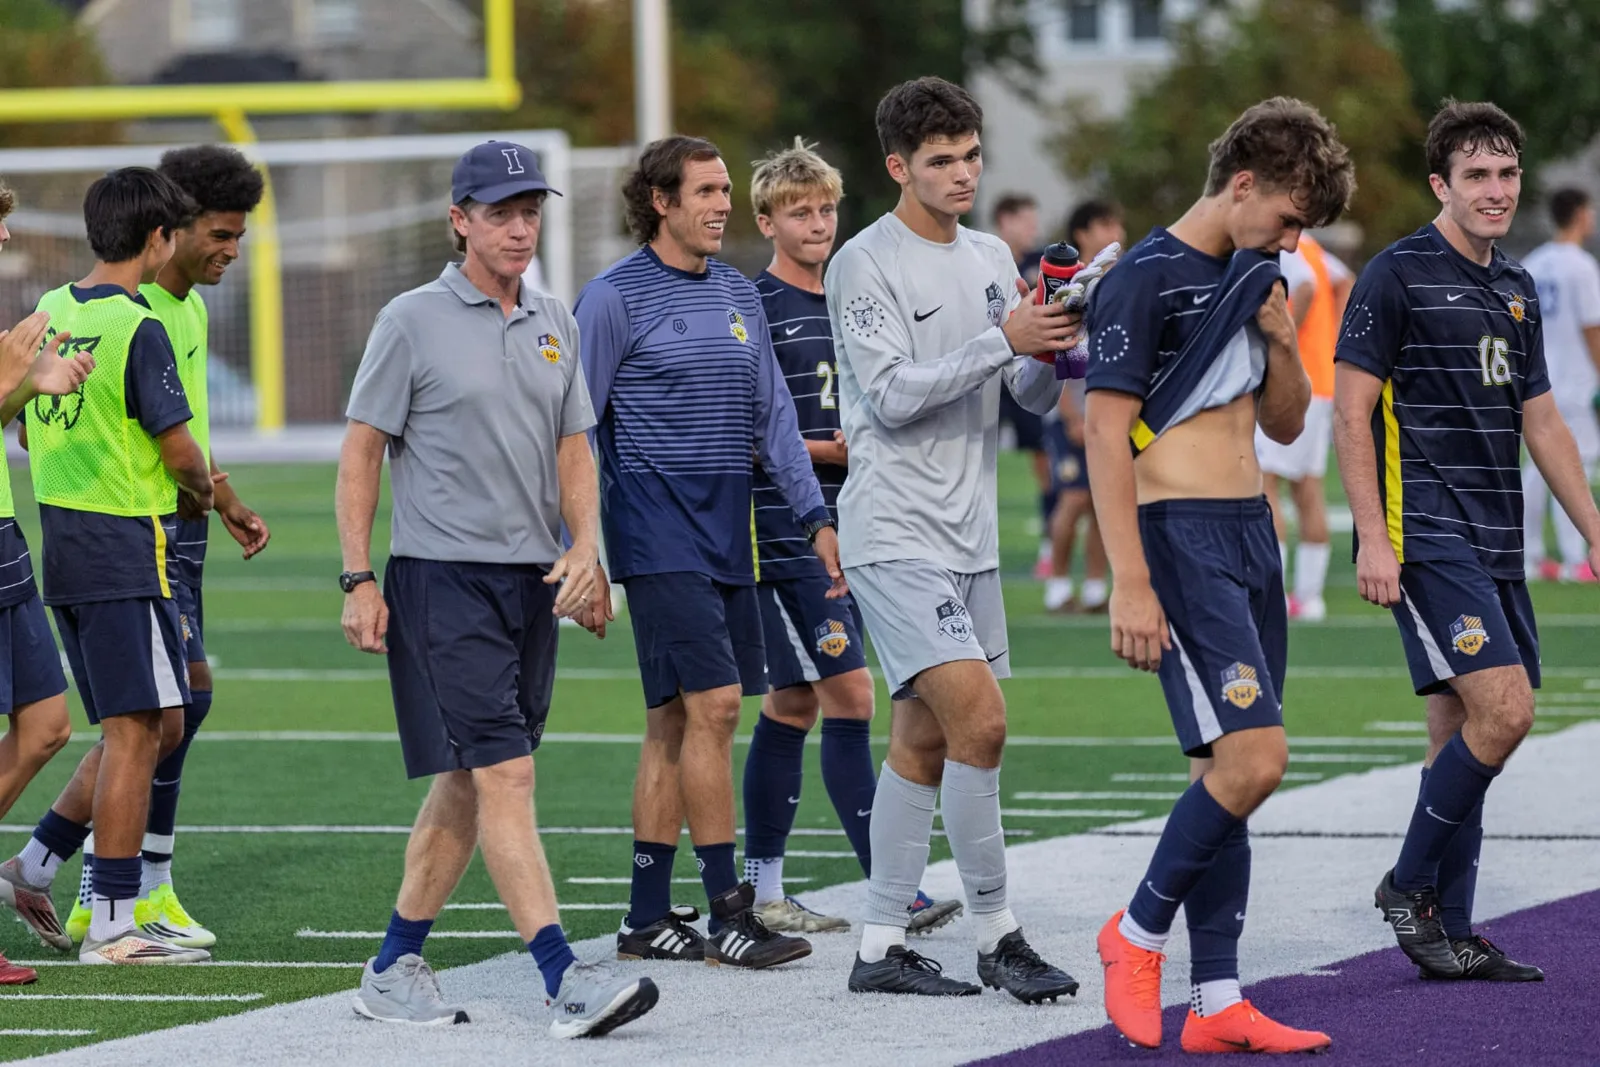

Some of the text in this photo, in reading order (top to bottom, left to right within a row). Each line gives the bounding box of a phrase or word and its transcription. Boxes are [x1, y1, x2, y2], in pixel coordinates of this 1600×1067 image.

[501, 148, 524, 174] I
[1478, 336, 1511, 386] 16
[816, 361, 838, 409] 2
[564, 1002, 586, 1015] HOKA
